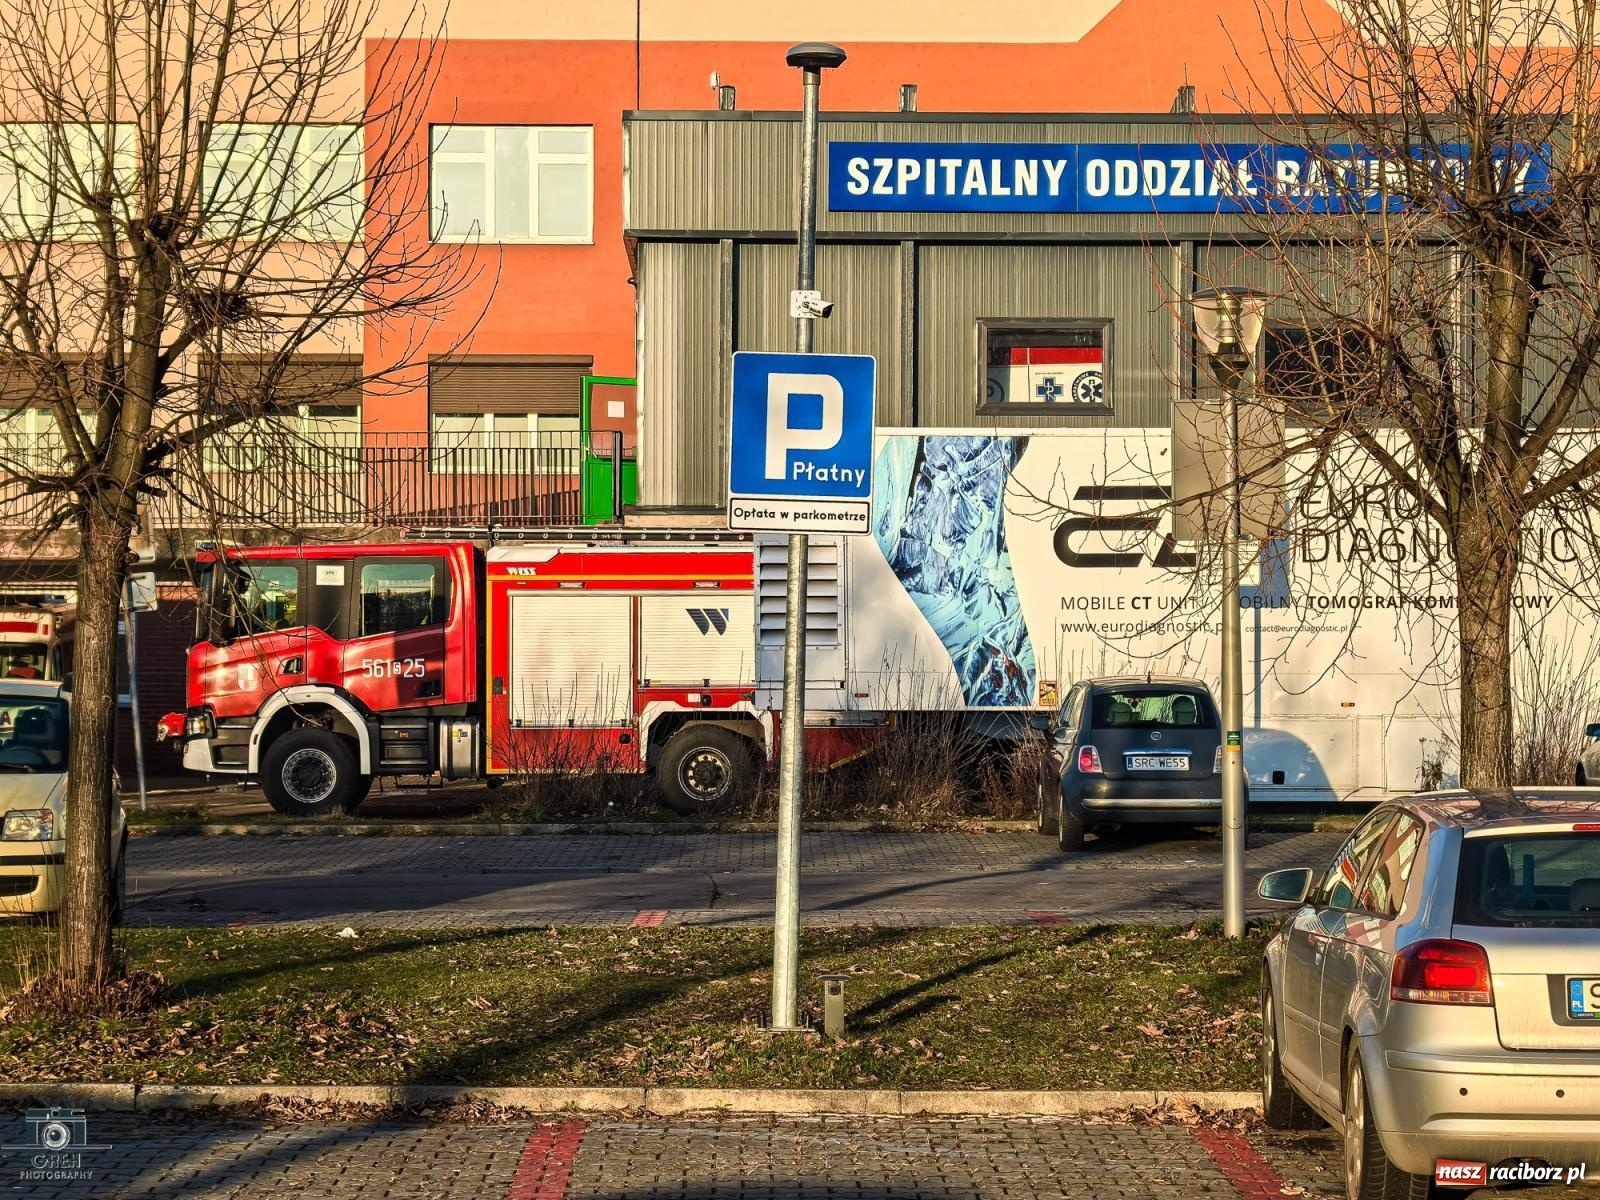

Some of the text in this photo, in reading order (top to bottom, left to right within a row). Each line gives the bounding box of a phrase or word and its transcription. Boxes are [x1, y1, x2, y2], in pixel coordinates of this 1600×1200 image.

[846, 156, 1068, 196] SZPITALNY
[1086, 158, 1258, 197] ODDZIAŁ
[765, 373, 844, 480] P
[793, 461, 866, 488] Płatny
[733, 507, 866, 522] Opłata w parkometrze
[1302, 526, 1579, 564] DIAGNTIC
[1061, 596, 1125, 610] MOBILE
[1131, 596, 1152, 610] CT
[1158, 596, 1198, 610] UNIT
[1239, 595, 1300, 609] OBILNY
[1061, 619, 1223, 636] www.eurodiagnostic.p
[1134, 758, 1186, 768] SRC WE55
[1572, 1000, 1583, 1009] PL
